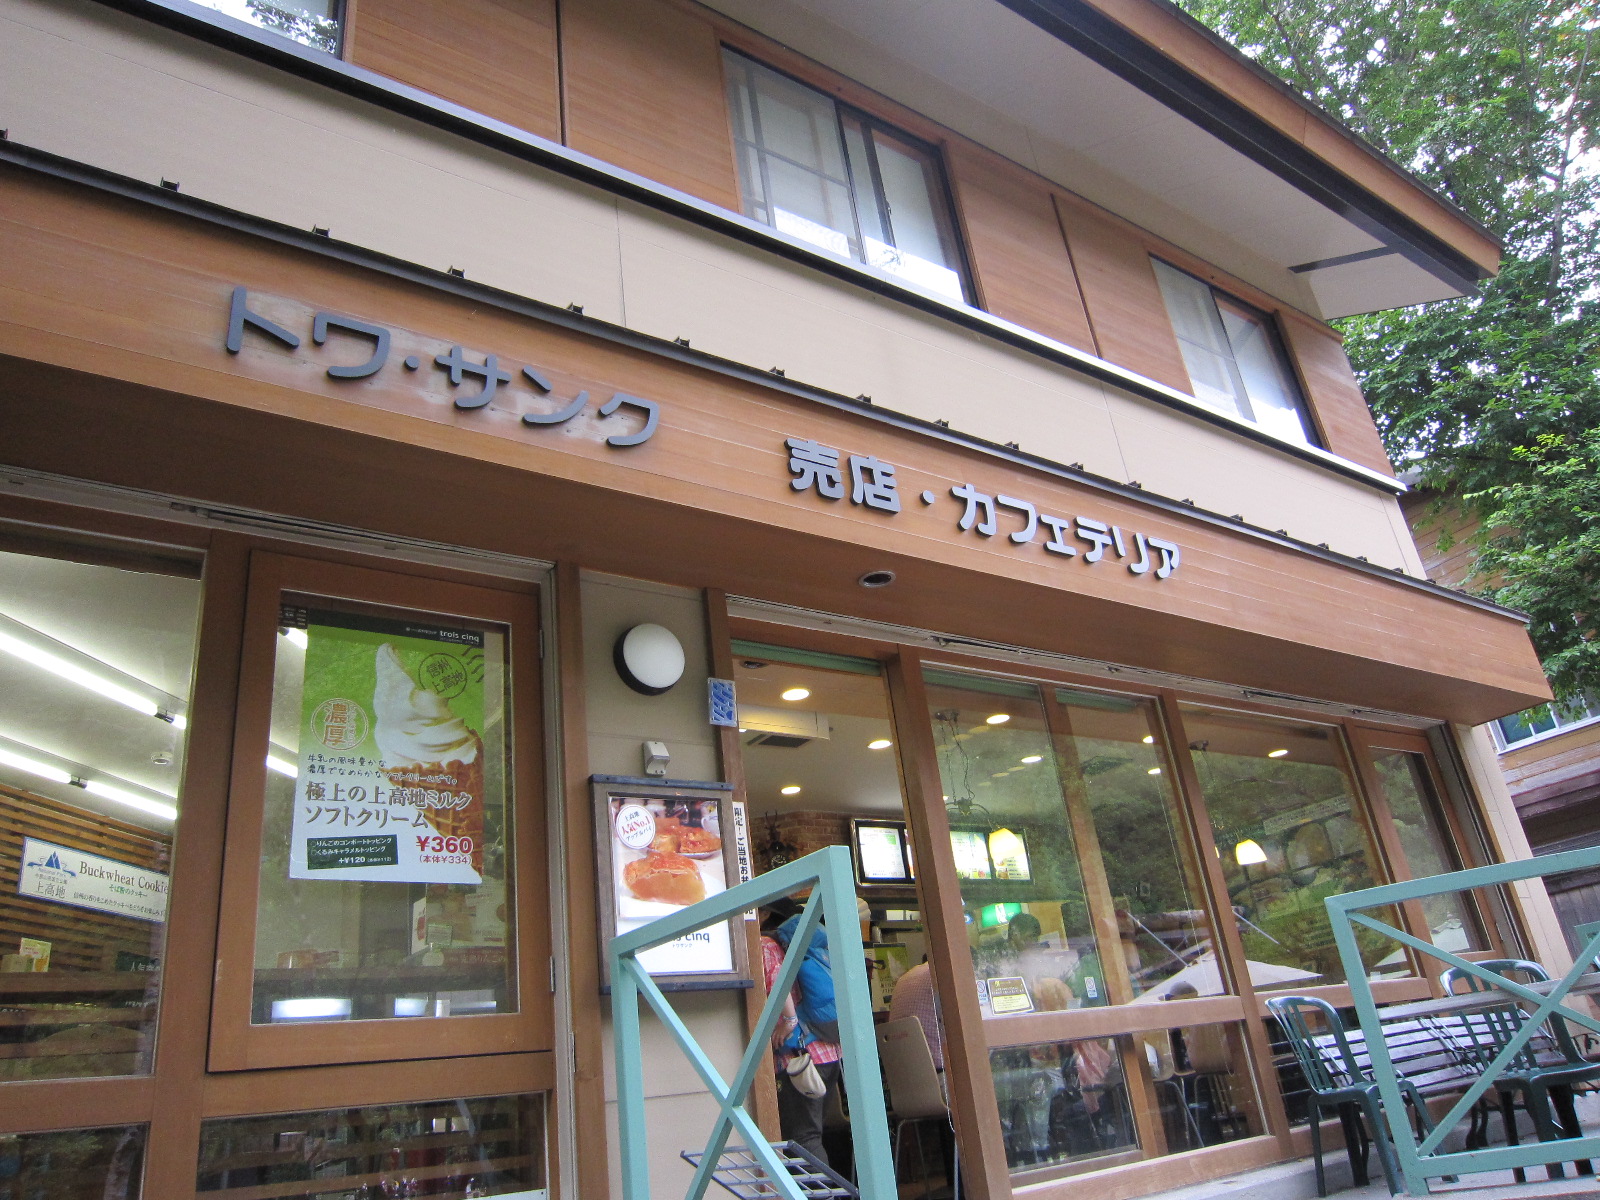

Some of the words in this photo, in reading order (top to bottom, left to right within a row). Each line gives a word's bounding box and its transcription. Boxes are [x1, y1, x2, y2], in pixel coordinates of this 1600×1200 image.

[226, 285, 660, 447] トワ・サンク
[784, 437, 1181, 580] 売店・カフェテリア
[440, 630, 459, 639] trois
[461, 633, 480, 643] cinq
[322, 702, 347, 746] 濃厚
[307, 753, 387, 768] 牛乳の風味豊かな
[304, 780, 473, 811] 極上の上高地ミルク
[304, 805, 429, 829] ソフトクリーム
[416, 835, 473, 854] ¥360
[79, 860, 135, 887] Buckwheat
[35, 881, 66, 899] 上高地
[685, 932, 710, 943] cinq
